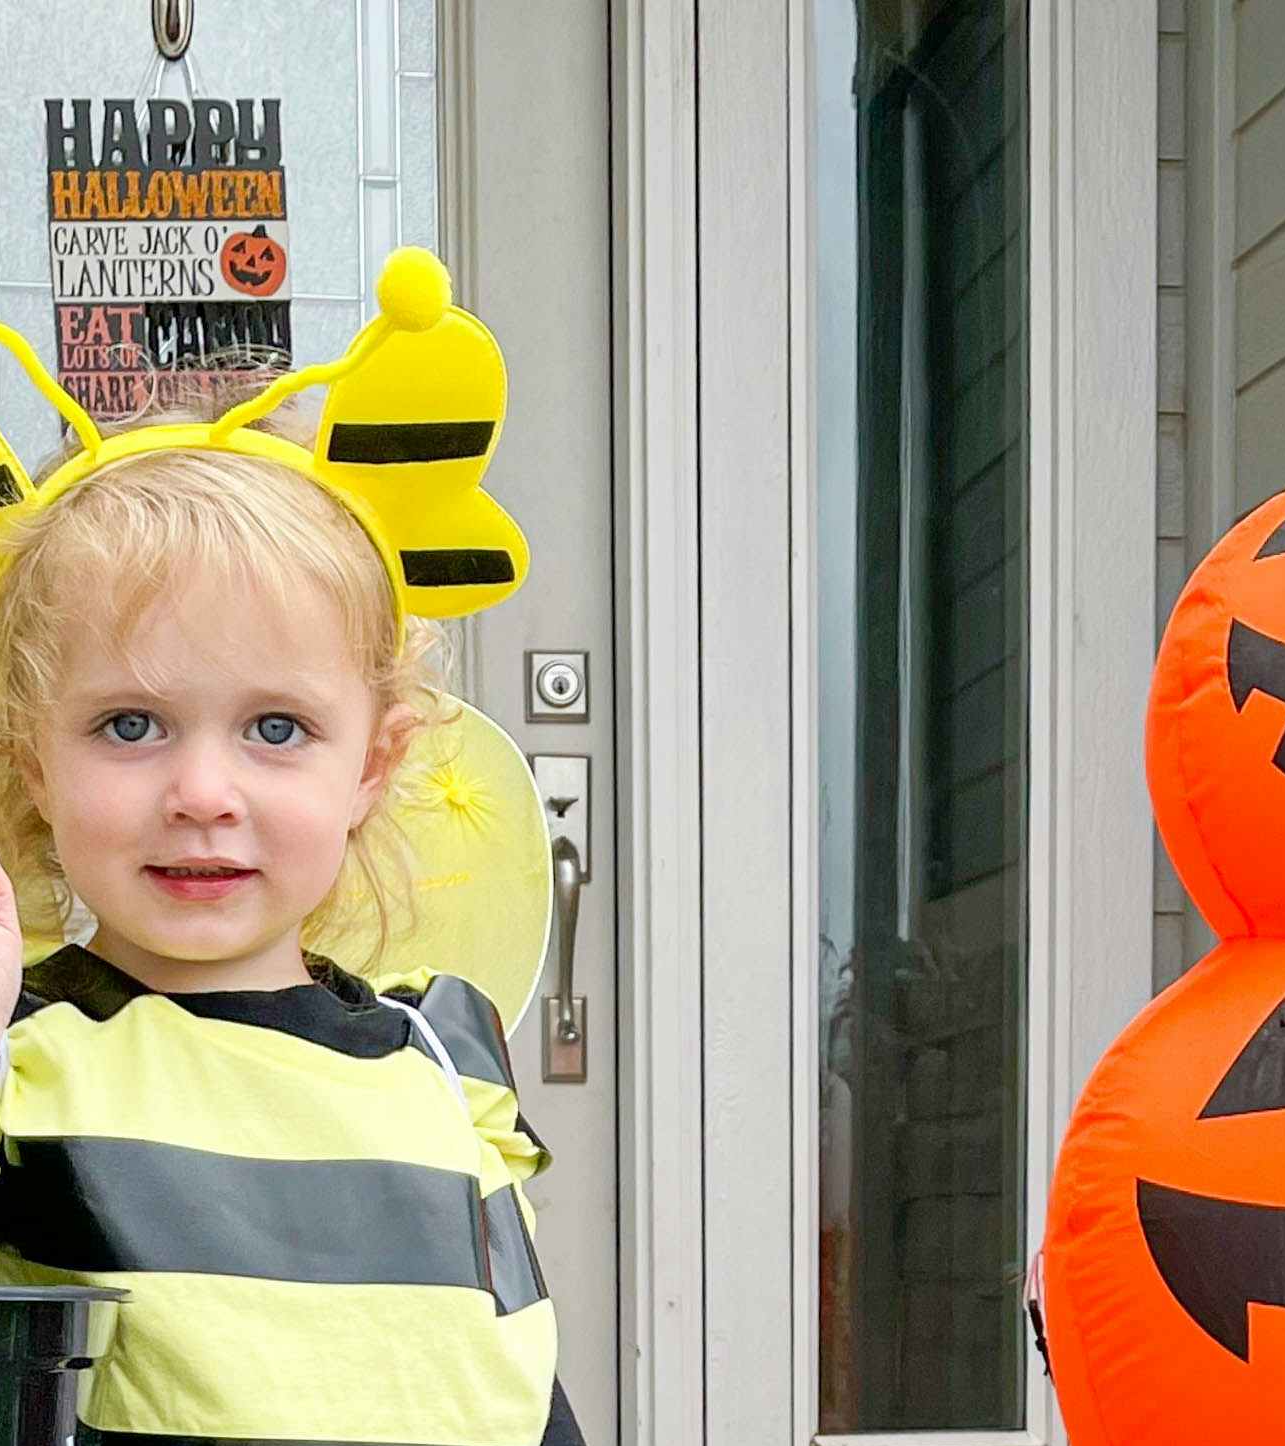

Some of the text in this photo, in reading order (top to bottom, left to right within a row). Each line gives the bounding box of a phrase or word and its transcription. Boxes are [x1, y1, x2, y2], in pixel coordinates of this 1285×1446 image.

[44, 99, 282, 167] HAPPY
[50, 170, 285, 219] HALLOWEEN
[54, 226, 127, 256] CARVE
[138, 225, 194, 255] JACK
[57, 258, 215, 298] LANTERNS
[59, 304, 144, 344] EAT
[62, 345, 110, 369] LOTS
[61, 374, 138, 414] SHARE
